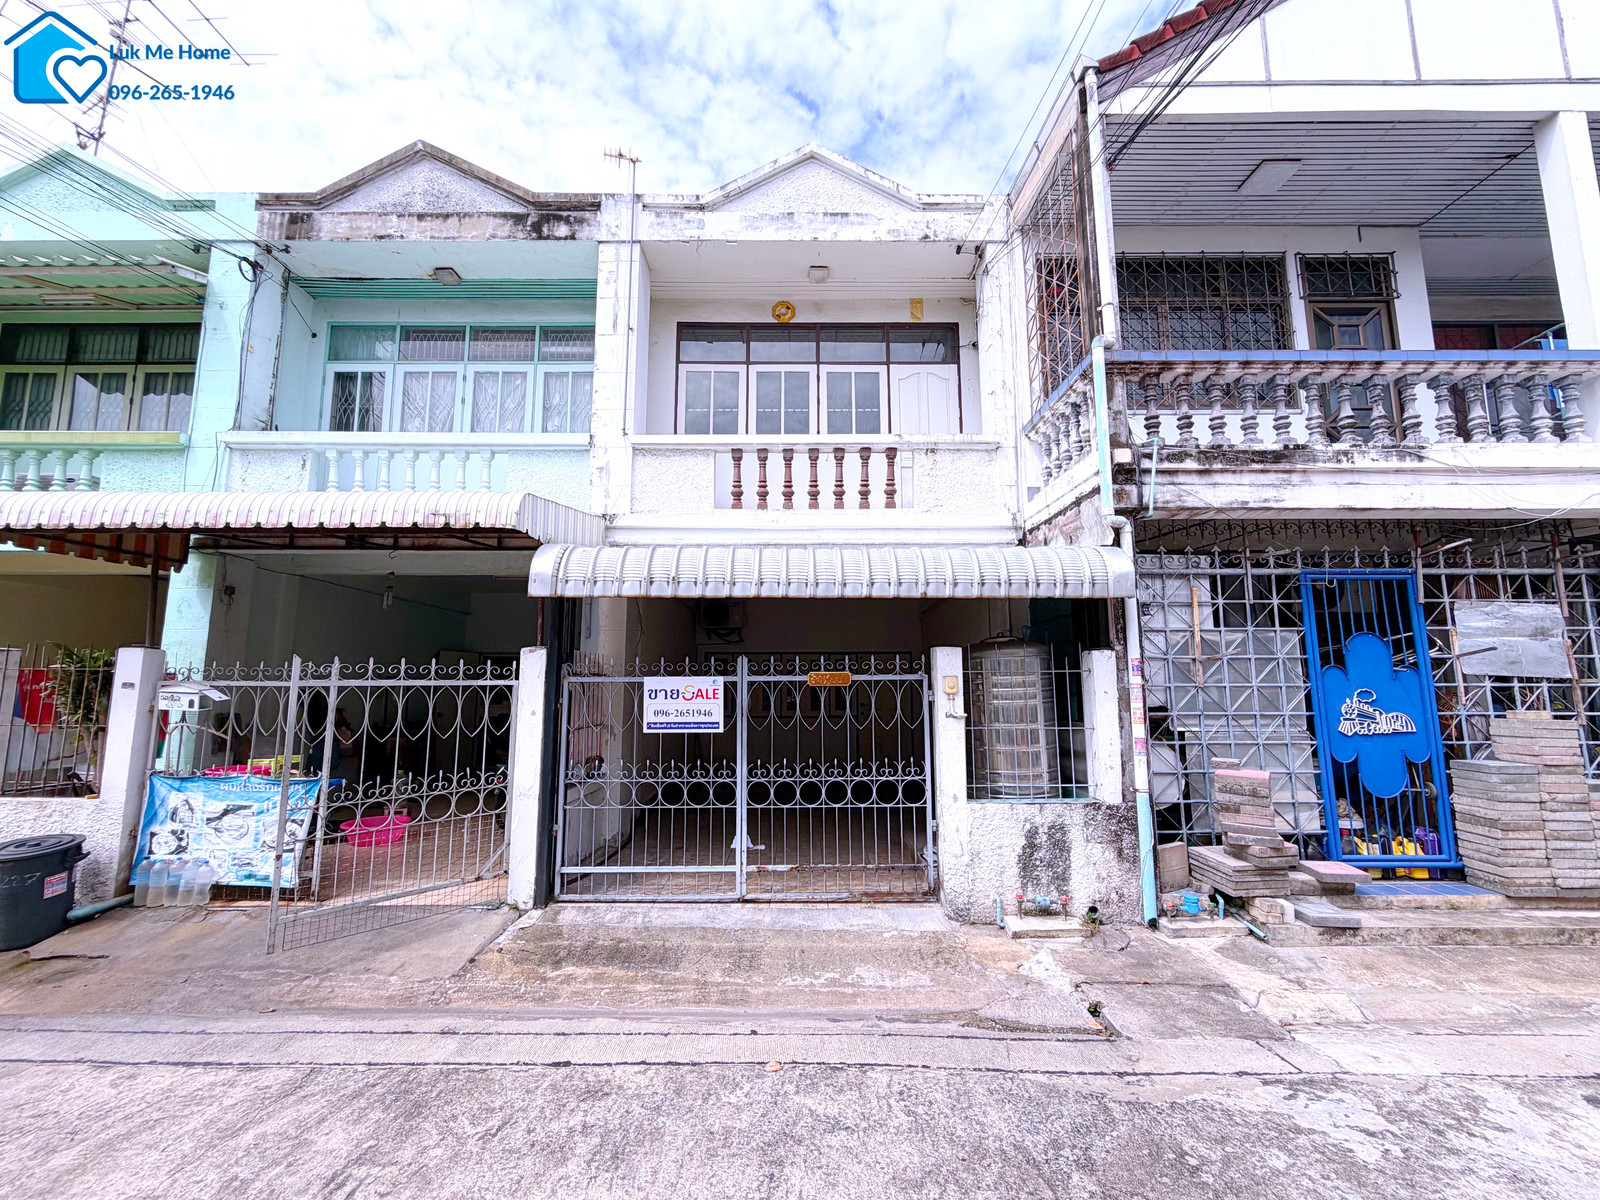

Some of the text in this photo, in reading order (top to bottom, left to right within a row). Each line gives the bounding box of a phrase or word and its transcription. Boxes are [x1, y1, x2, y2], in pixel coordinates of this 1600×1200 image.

[647, 684, 720, 702] ขาย SALE
[653, 708, 713, 718] 096-2651946
